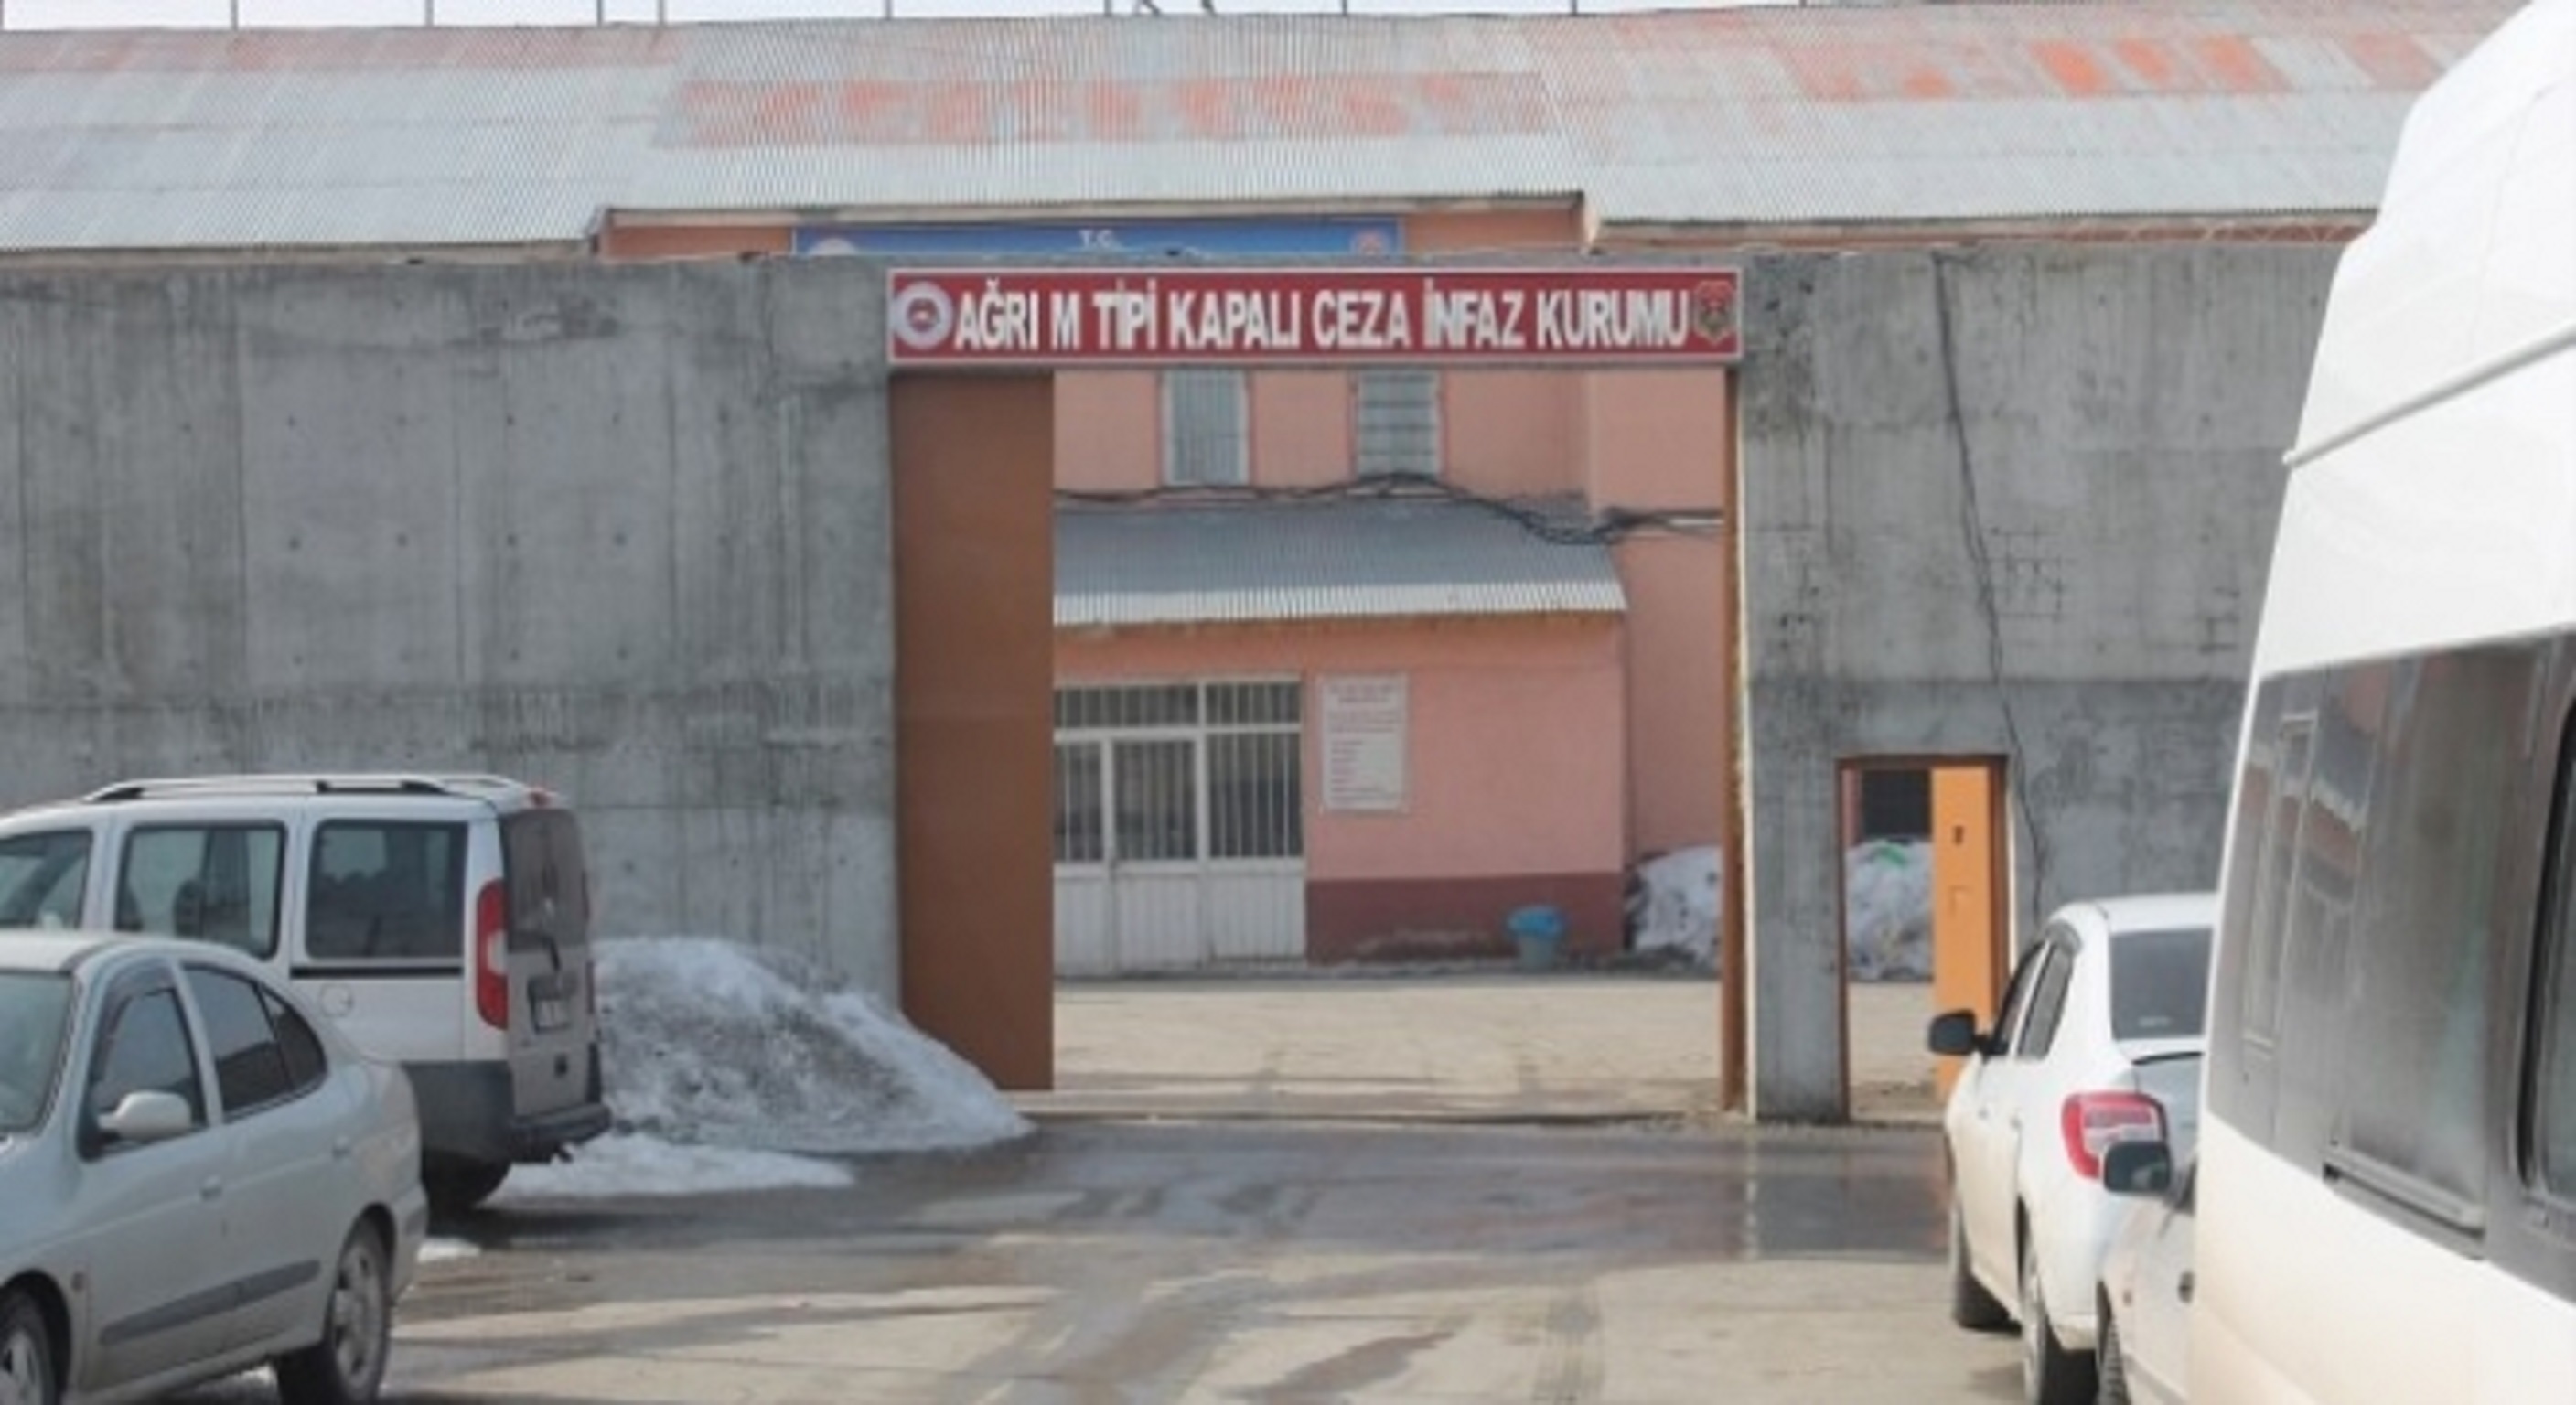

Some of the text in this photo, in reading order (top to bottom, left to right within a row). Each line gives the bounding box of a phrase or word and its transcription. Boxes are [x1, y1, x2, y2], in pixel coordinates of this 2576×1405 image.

[954, 276, 1690, 350] AĞRI M TİPİ KAPALI CEZA İNFAZ KURUMU
